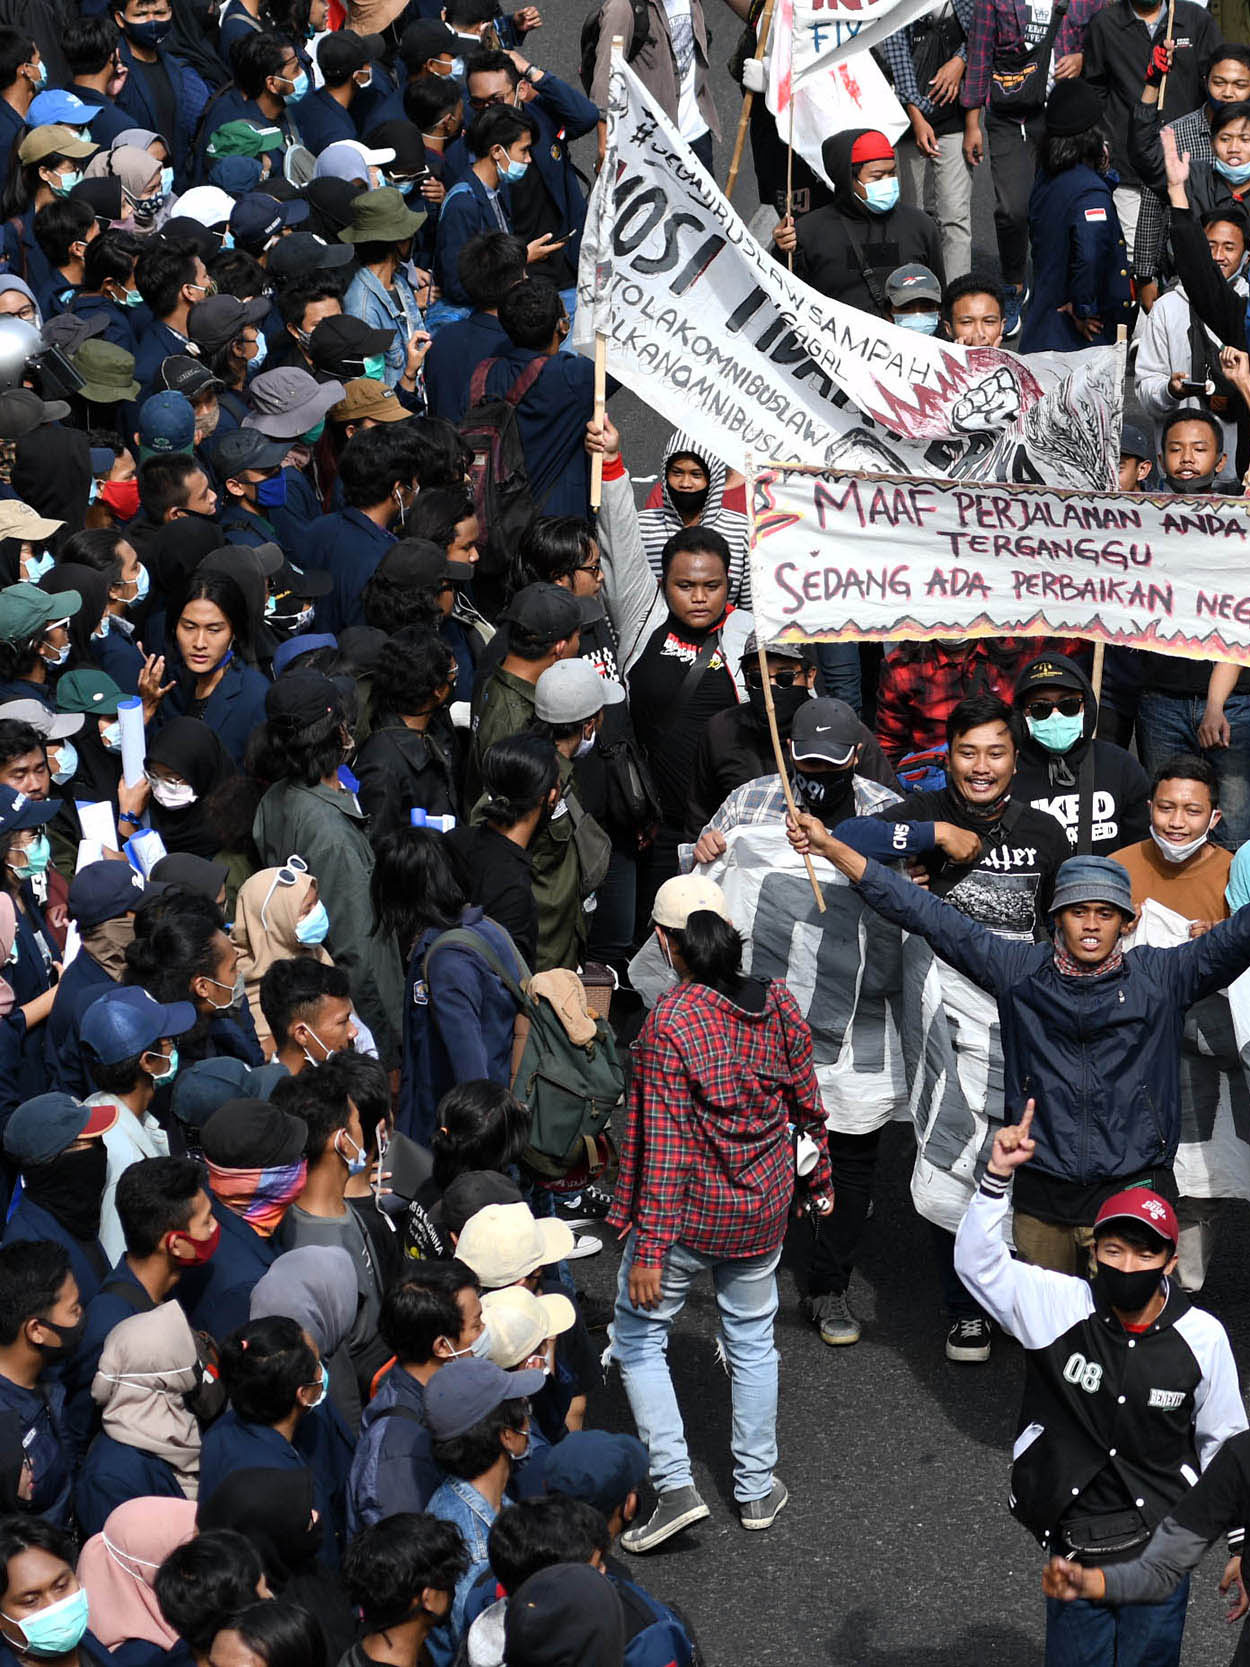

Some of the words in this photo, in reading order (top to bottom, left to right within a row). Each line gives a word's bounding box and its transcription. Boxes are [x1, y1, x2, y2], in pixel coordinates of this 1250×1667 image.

[813, 480, 936, 530] MAAF
[952, 490, 1142, 531] PERJALANAN
[1160, 513, 1248, 540] ANDA
[936, 531, 1152, 570] TERGANGGU
[774, 561, 911, 615] SEDANG
[923, 567, 992, 599] ADA
[1011, 570, 1174, 618] PERBAIKAN
[893, 823, 910, 850] CNS
[1063, 1352, 1103, 1394] 08
